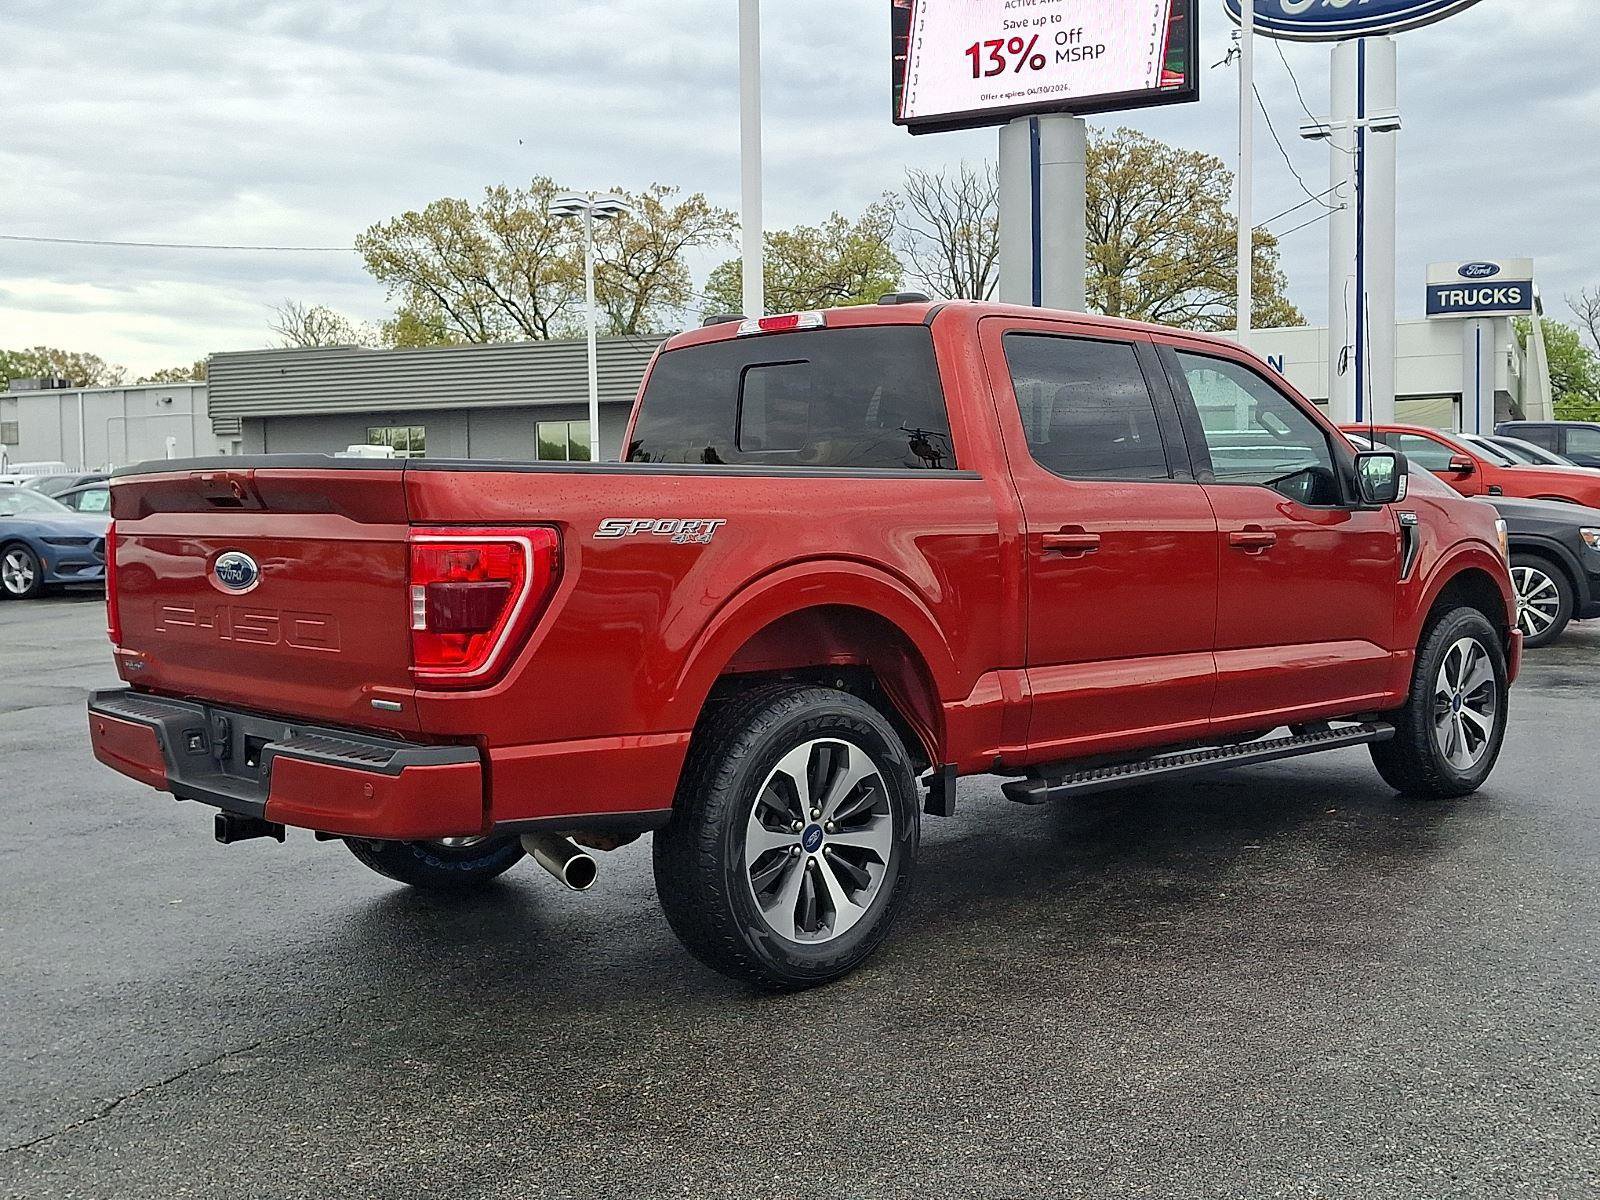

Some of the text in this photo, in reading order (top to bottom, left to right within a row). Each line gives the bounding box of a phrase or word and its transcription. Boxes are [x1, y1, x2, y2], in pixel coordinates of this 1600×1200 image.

[1003, 14, 1062, 31] Save up to
[1054, 28, 1083, 46] Off
[965, 34, 1047, 79] 13%
[1055, 44, 1106, 64] MSRP
[980, 93, 998, 101] Offer
[1000, 90, 1026, 100] expires
[1466, 264, 1492, 276] Ford
[1437, 286, 1522, 307] TRUCKS
[592, 517, 727, 540] SPORT
[220, 558, 245, 581] Ford
[153, 599, 342, 653] F-150
